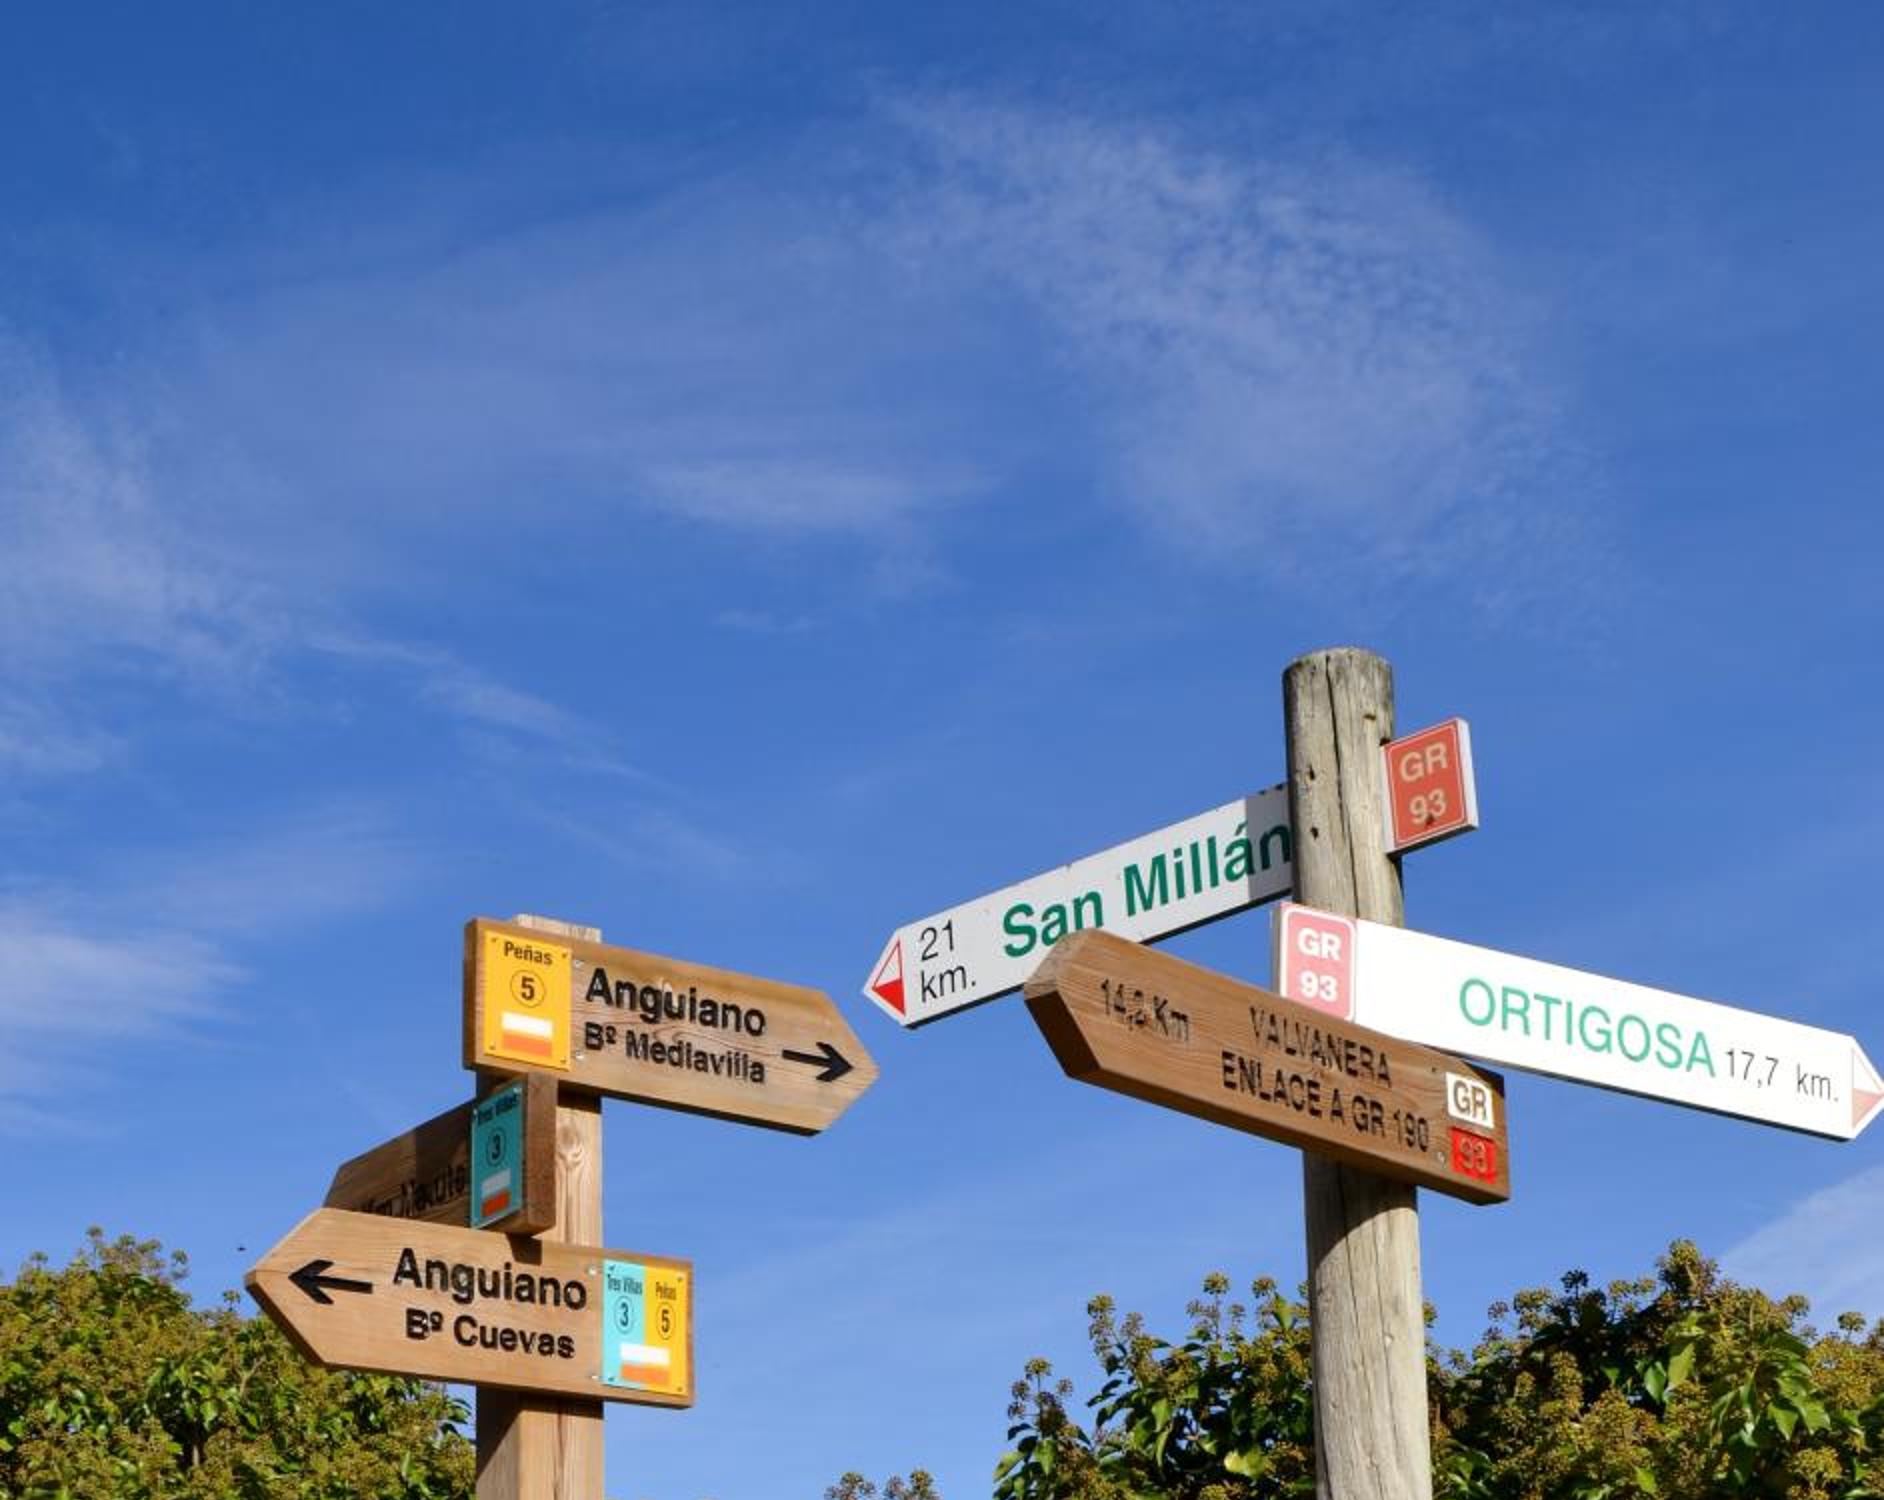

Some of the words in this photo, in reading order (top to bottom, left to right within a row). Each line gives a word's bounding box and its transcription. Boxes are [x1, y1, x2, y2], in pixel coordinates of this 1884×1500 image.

[1400, 742, 1448, 782] GR
[1409, 788, 1446, 825] 93
[1003, 890, 1104, 958] San
[1123, 820, 1292, 918] Millán
[504, 941, 552, 965] Peñas
[920, 919, 954, 962] 21
[1298, 927, 1341, 961] GR
[520, 975, 537, 1001] 5
[585, 967, 766, 1036] Anguiano
[920, 964, 976, 1003] km.
[1299, 970, 1337, 1003] 93
[1153, 995, 1189, 1042] Km
[625, 1029, 765, 1083] Mediavilla
[1250, 1005, 1392, 1089] VALVANERA
[1459, 978, 1716, 1077] ORTIGOSA
[1725, 1048, 1779, 1089] 17,7
[1797, 1062, 1838, 1102] km.
[1221, 1050, 1323, 1119] ENLACE
[1329, 1088, 1345, 1126] A
[1352, 1095, 1387, 1138] GR
[1393, 1108, 1430, 1152] 190
[1453, 1080, 1489, 1121] GR
[491, 1132, 502, 1160] 3
[1461, 1137, 1489, 1173] 93
[393, 1247, 587, 1311] Anguiano
[620, 1302, 629, 1327] 3
[661, 1308, 671, 1333] 5
[453, 1315, 576, 1359] Cuevas
